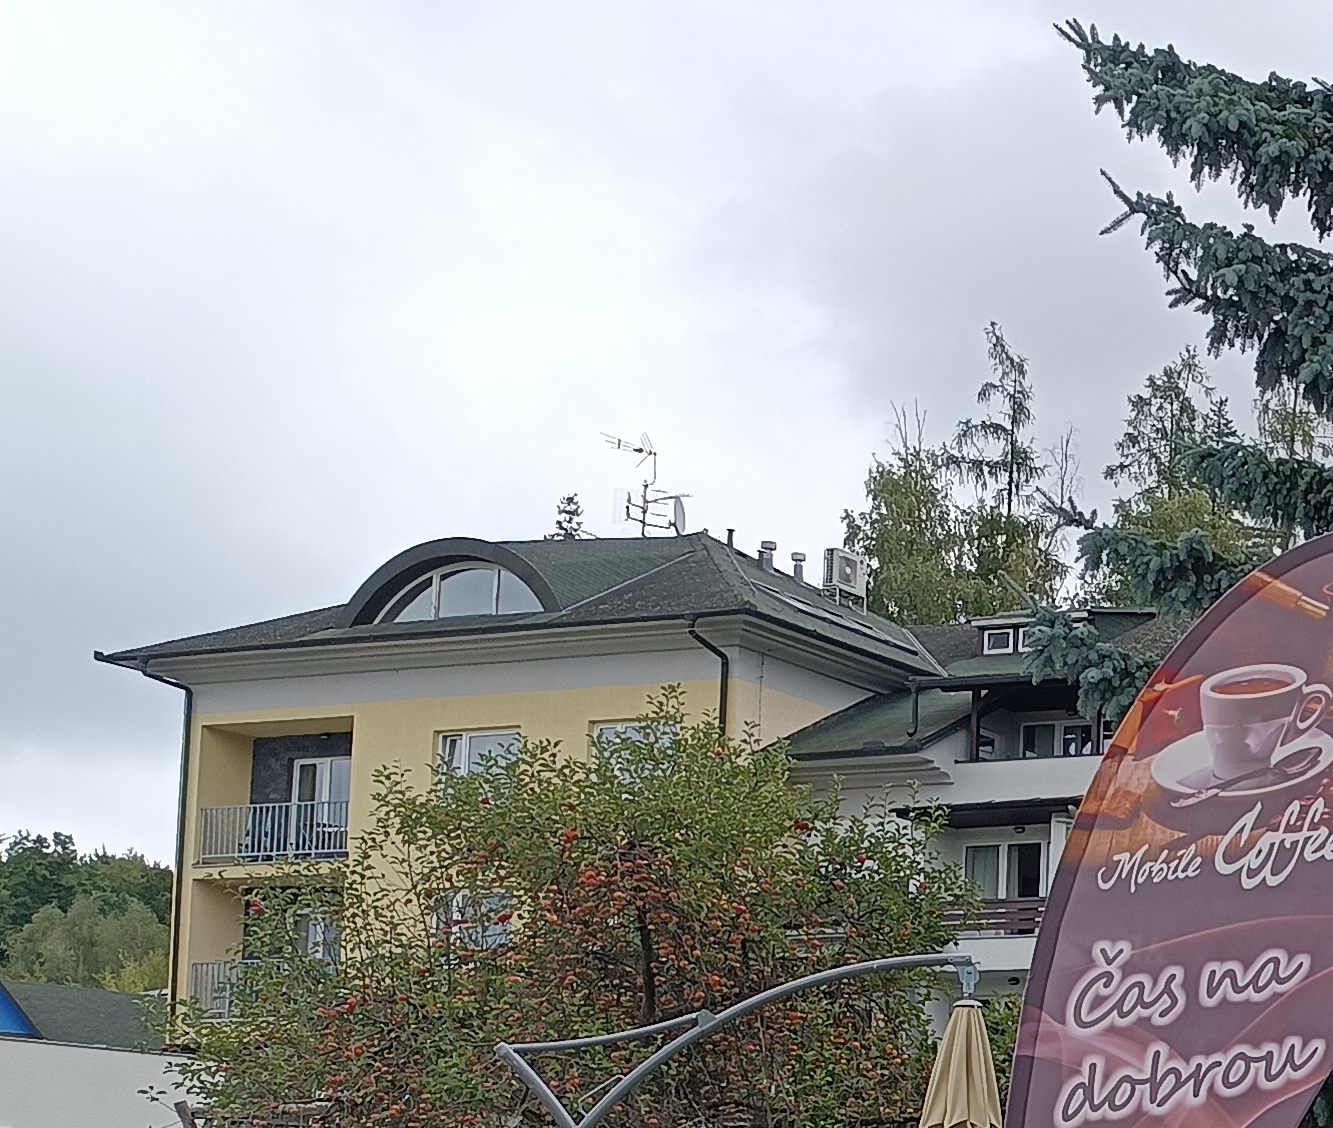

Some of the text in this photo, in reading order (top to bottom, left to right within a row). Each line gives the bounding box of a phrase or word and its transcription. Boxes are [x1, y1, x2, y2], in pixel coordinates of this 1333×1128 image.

[1098, 847, 1203, 894] Mobile
[1070, 945, 1306, 1032] Čas na
[1058, 1040, 1322, 1127] dobrou
